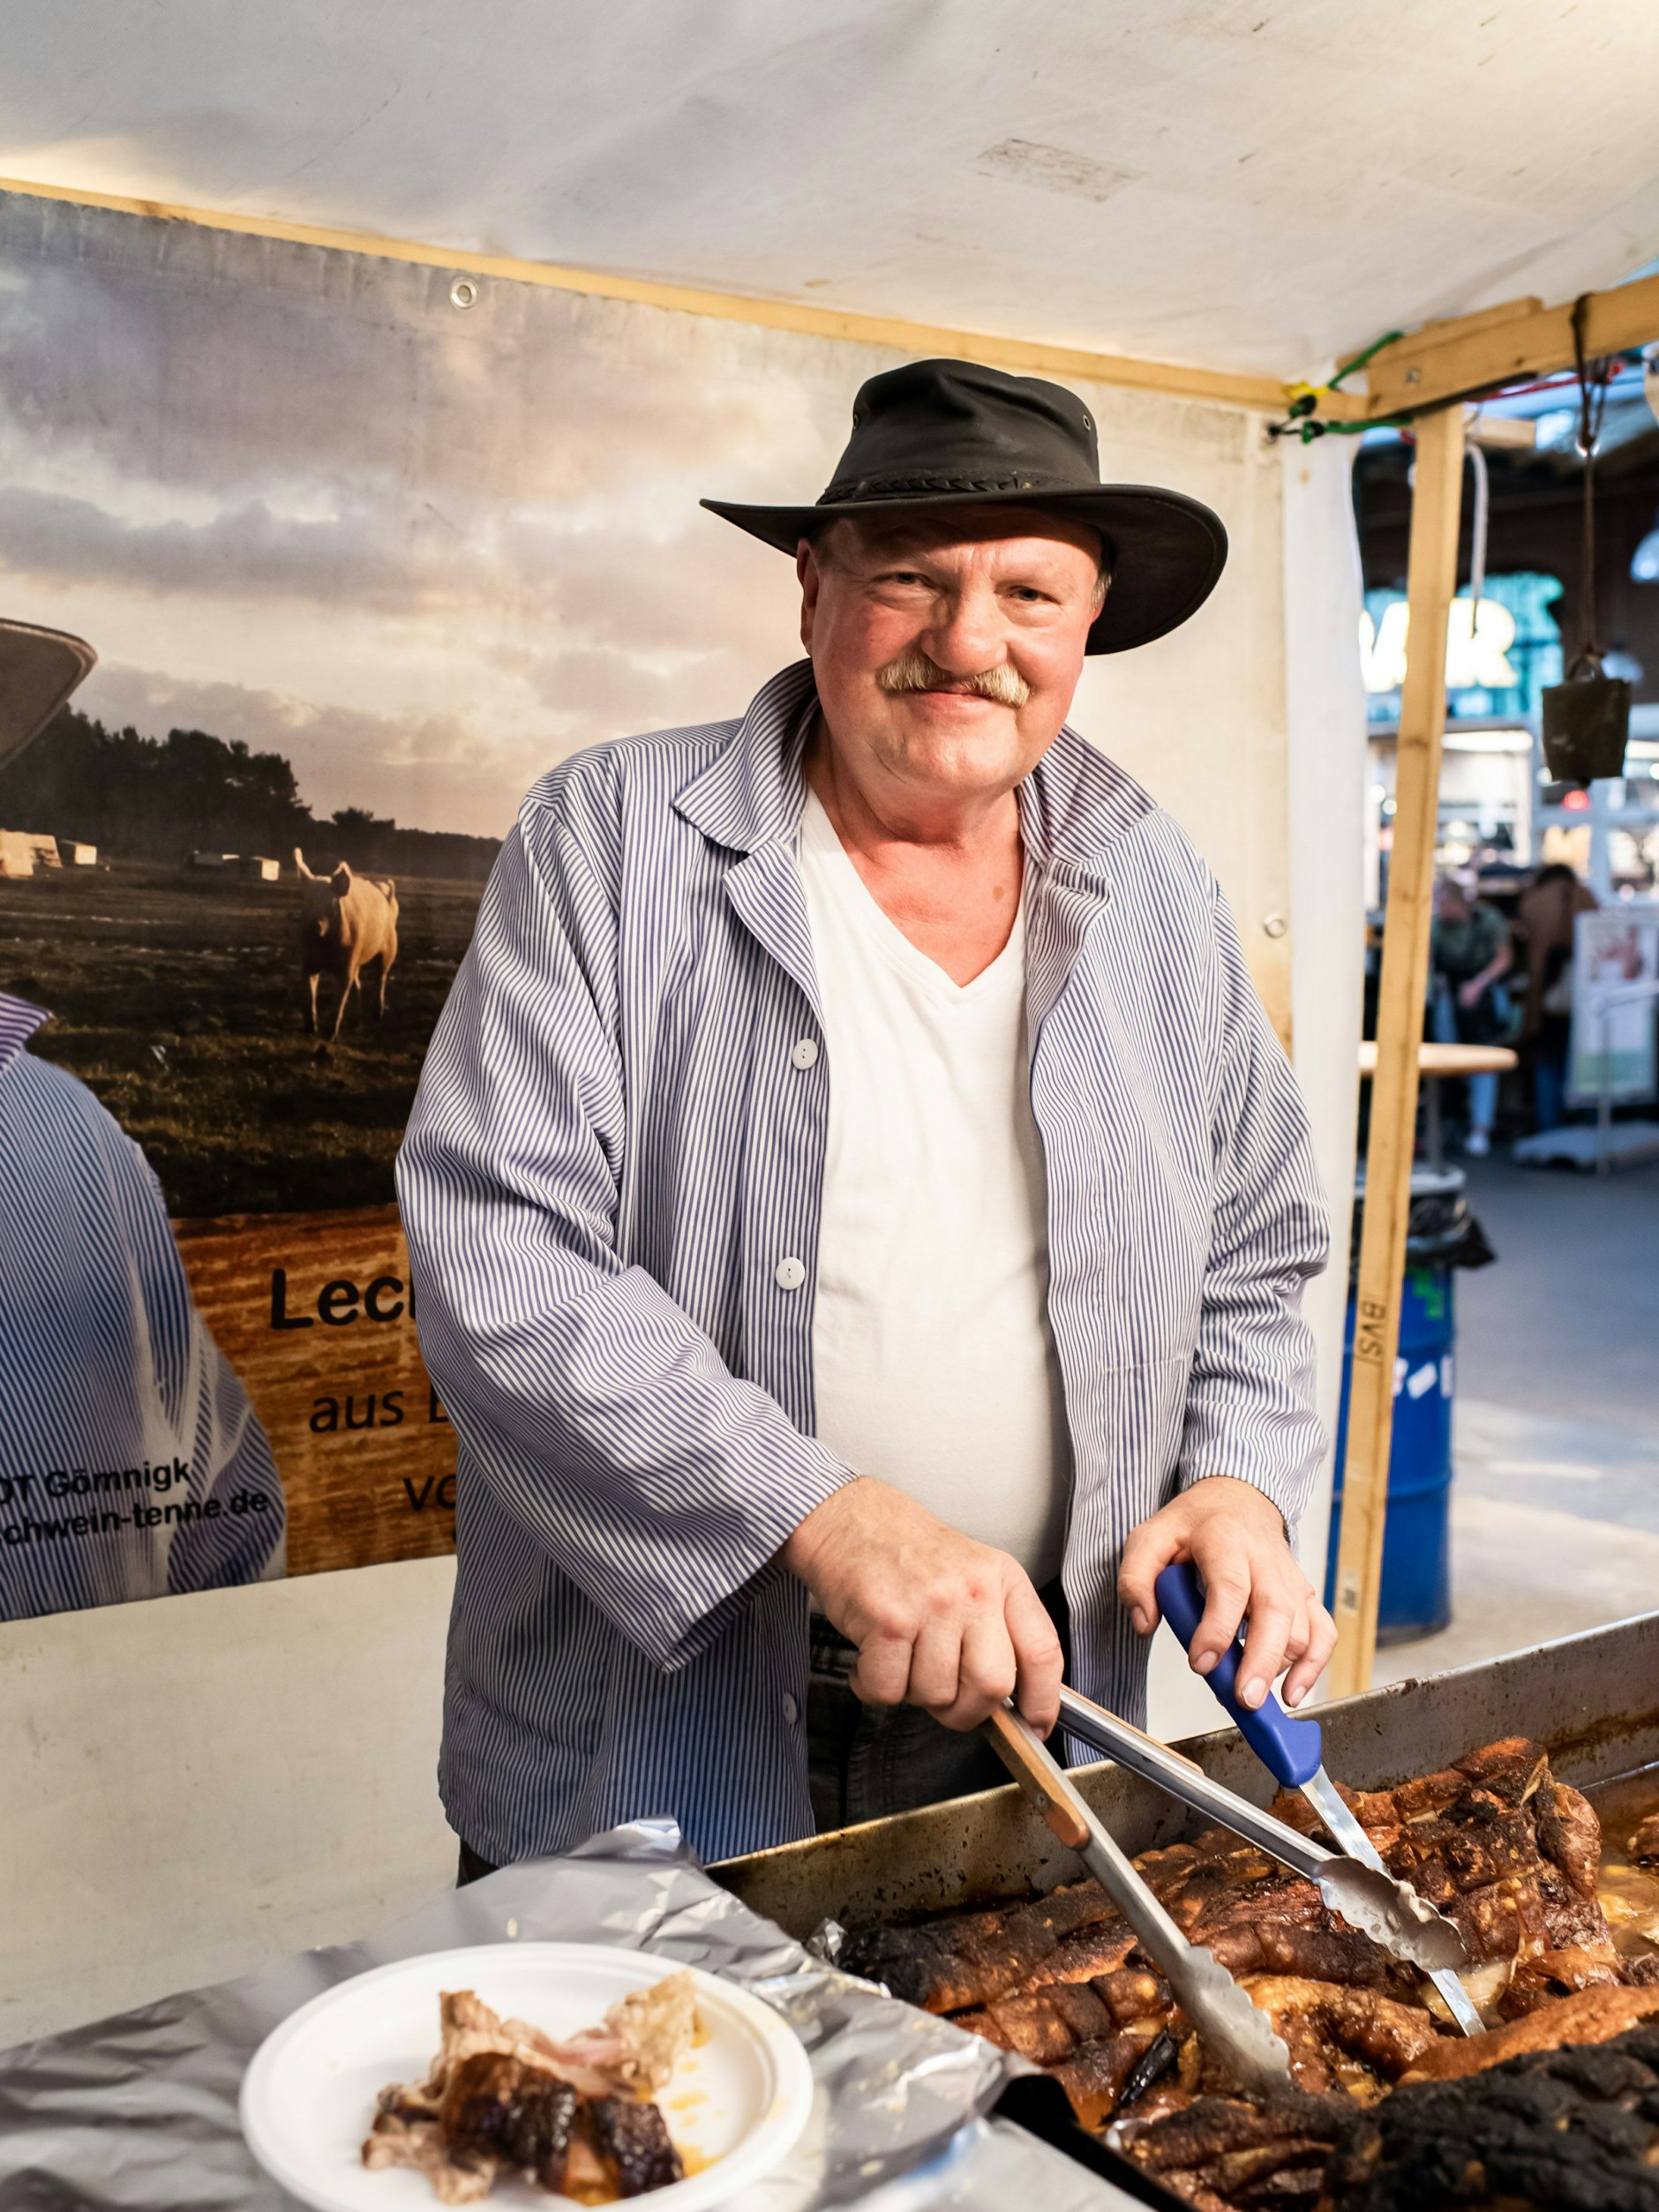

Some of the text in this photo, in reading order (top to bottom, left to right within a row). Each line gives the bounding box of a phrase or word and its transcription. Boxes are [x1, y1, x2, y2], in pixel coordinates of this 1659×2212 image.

[1359, 1301, 1385, 1357] BVS
[309, 1390, 404, 1434] aus
[45, 1458, 191, 1498] Gömnigk
[0, 1488, 269, 1545] chwein-tenne.de
